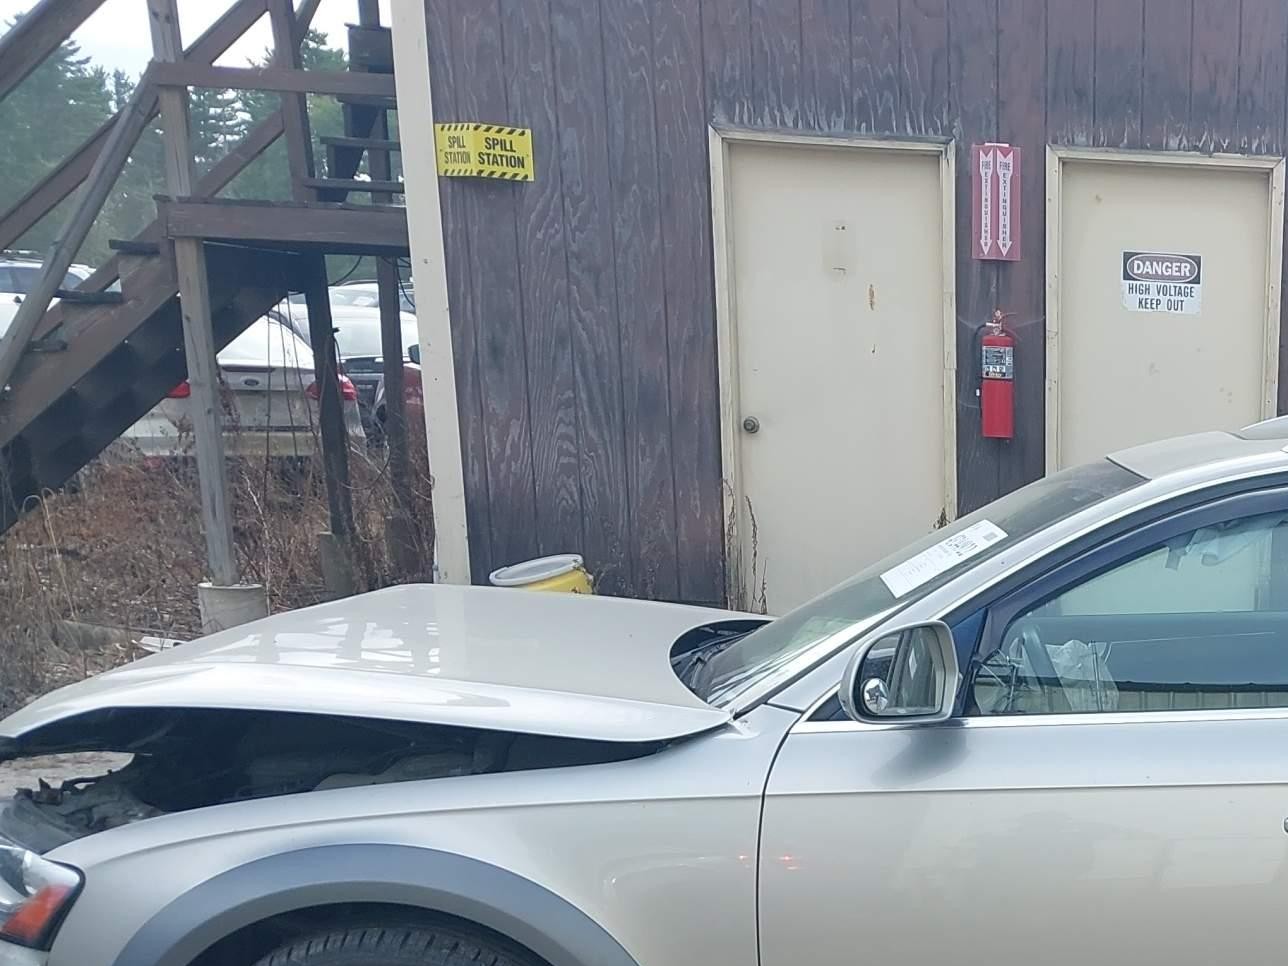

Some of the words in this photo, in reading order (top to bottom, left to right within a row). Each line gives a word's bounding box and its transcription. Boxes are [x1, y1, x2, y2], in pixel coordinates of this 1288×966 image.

[448, 135, 466, 149] SPILL
[484, 137, 516, 153] SPILL
[444, 151, 471, 164] STATION
[478, 152, 524, 168] STATION
[981, 161, 991, 170] FIRE
[1000, 161, 1010, 171] FIRE
[1133, 260, 1191, 276] DANGER
[1128, 283, 1151, 295] HIGH
[1156, 284, 1195, 298] VOLTAGE
[1138, 297, 1161, 310] KEEP
[1166, 299, 1184, 311] OUT
